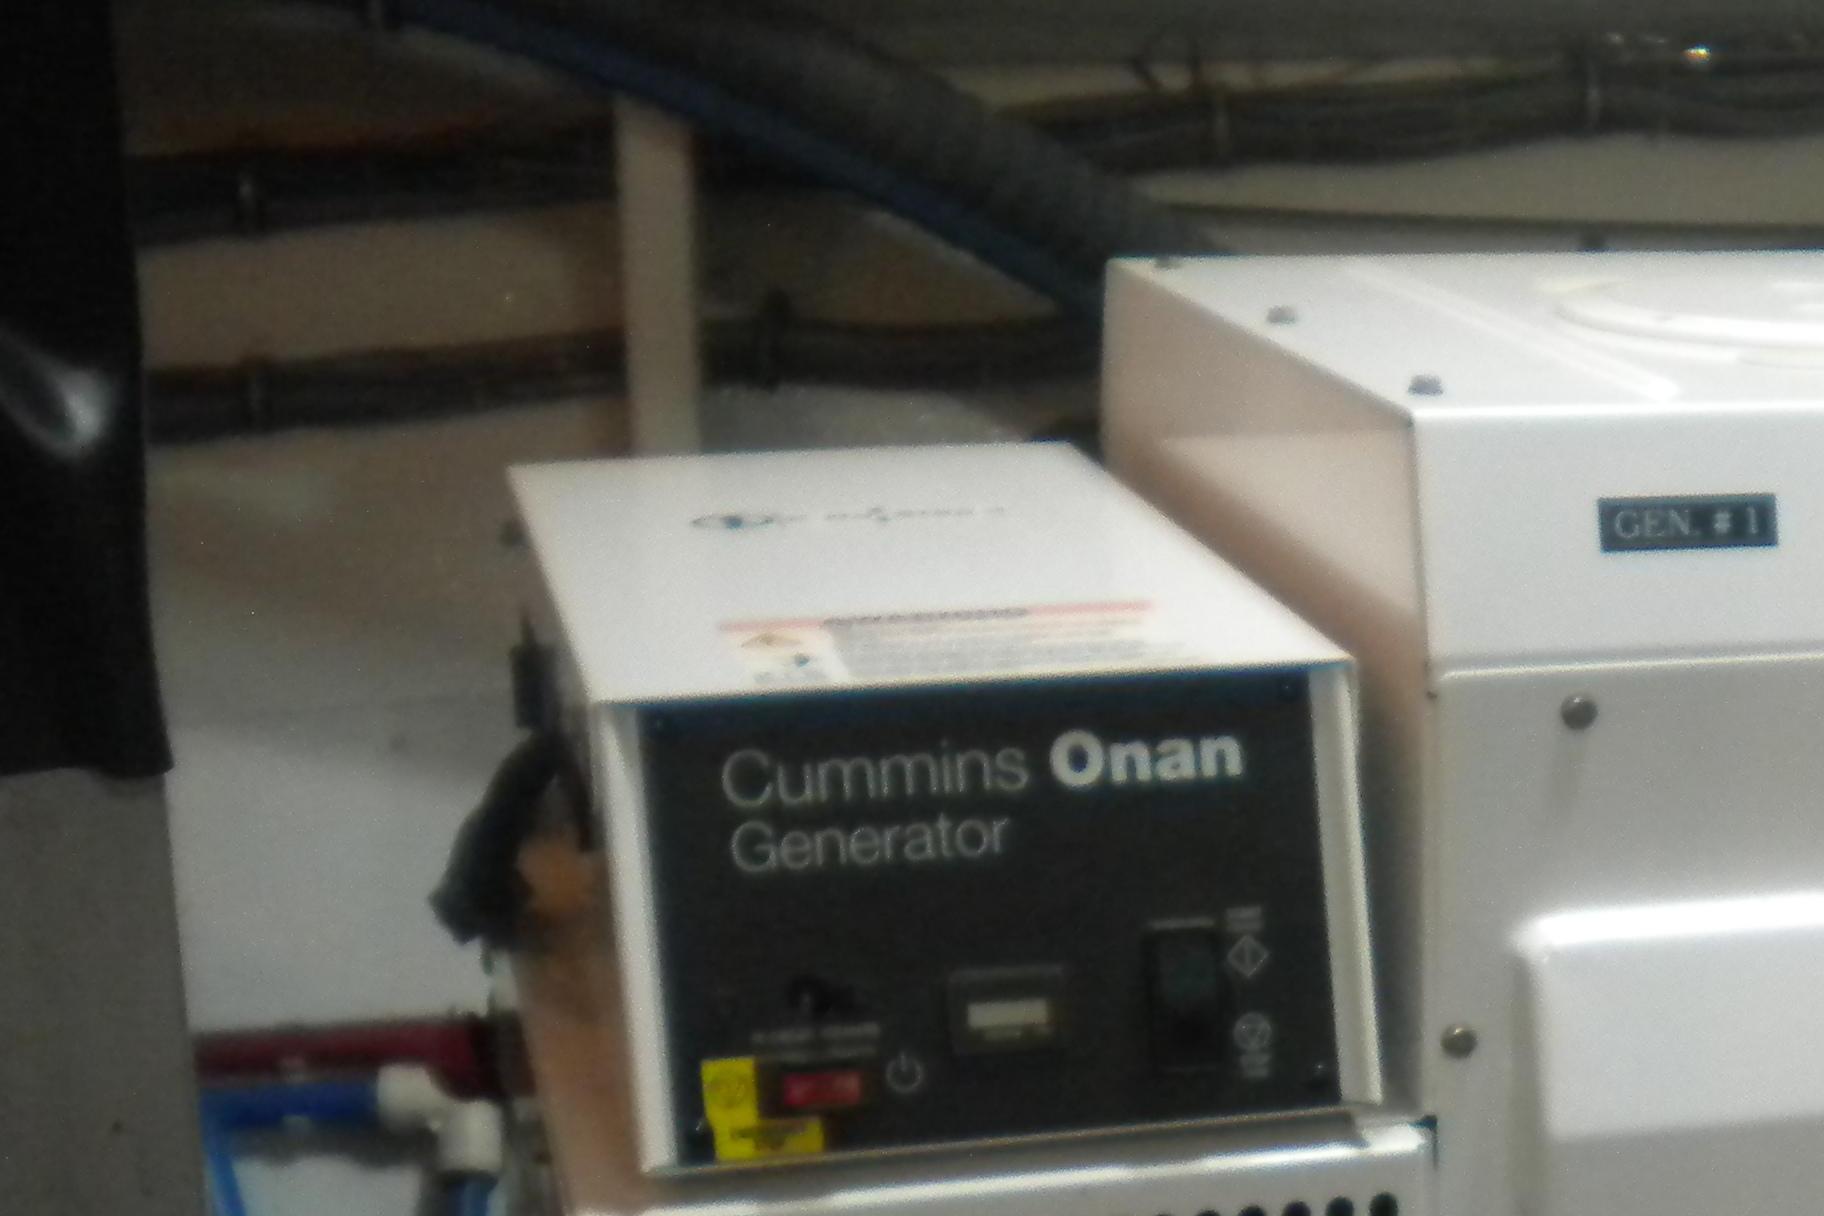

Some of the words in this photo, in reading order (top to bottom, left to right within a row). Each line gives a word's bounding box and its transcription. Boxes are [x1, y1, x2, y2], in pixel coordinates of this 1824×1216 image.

[721, 738, 1031, 811] Cummins
[1048, 728, 1245, 790] Onan
[729, 812, 1010, 875] Generator
